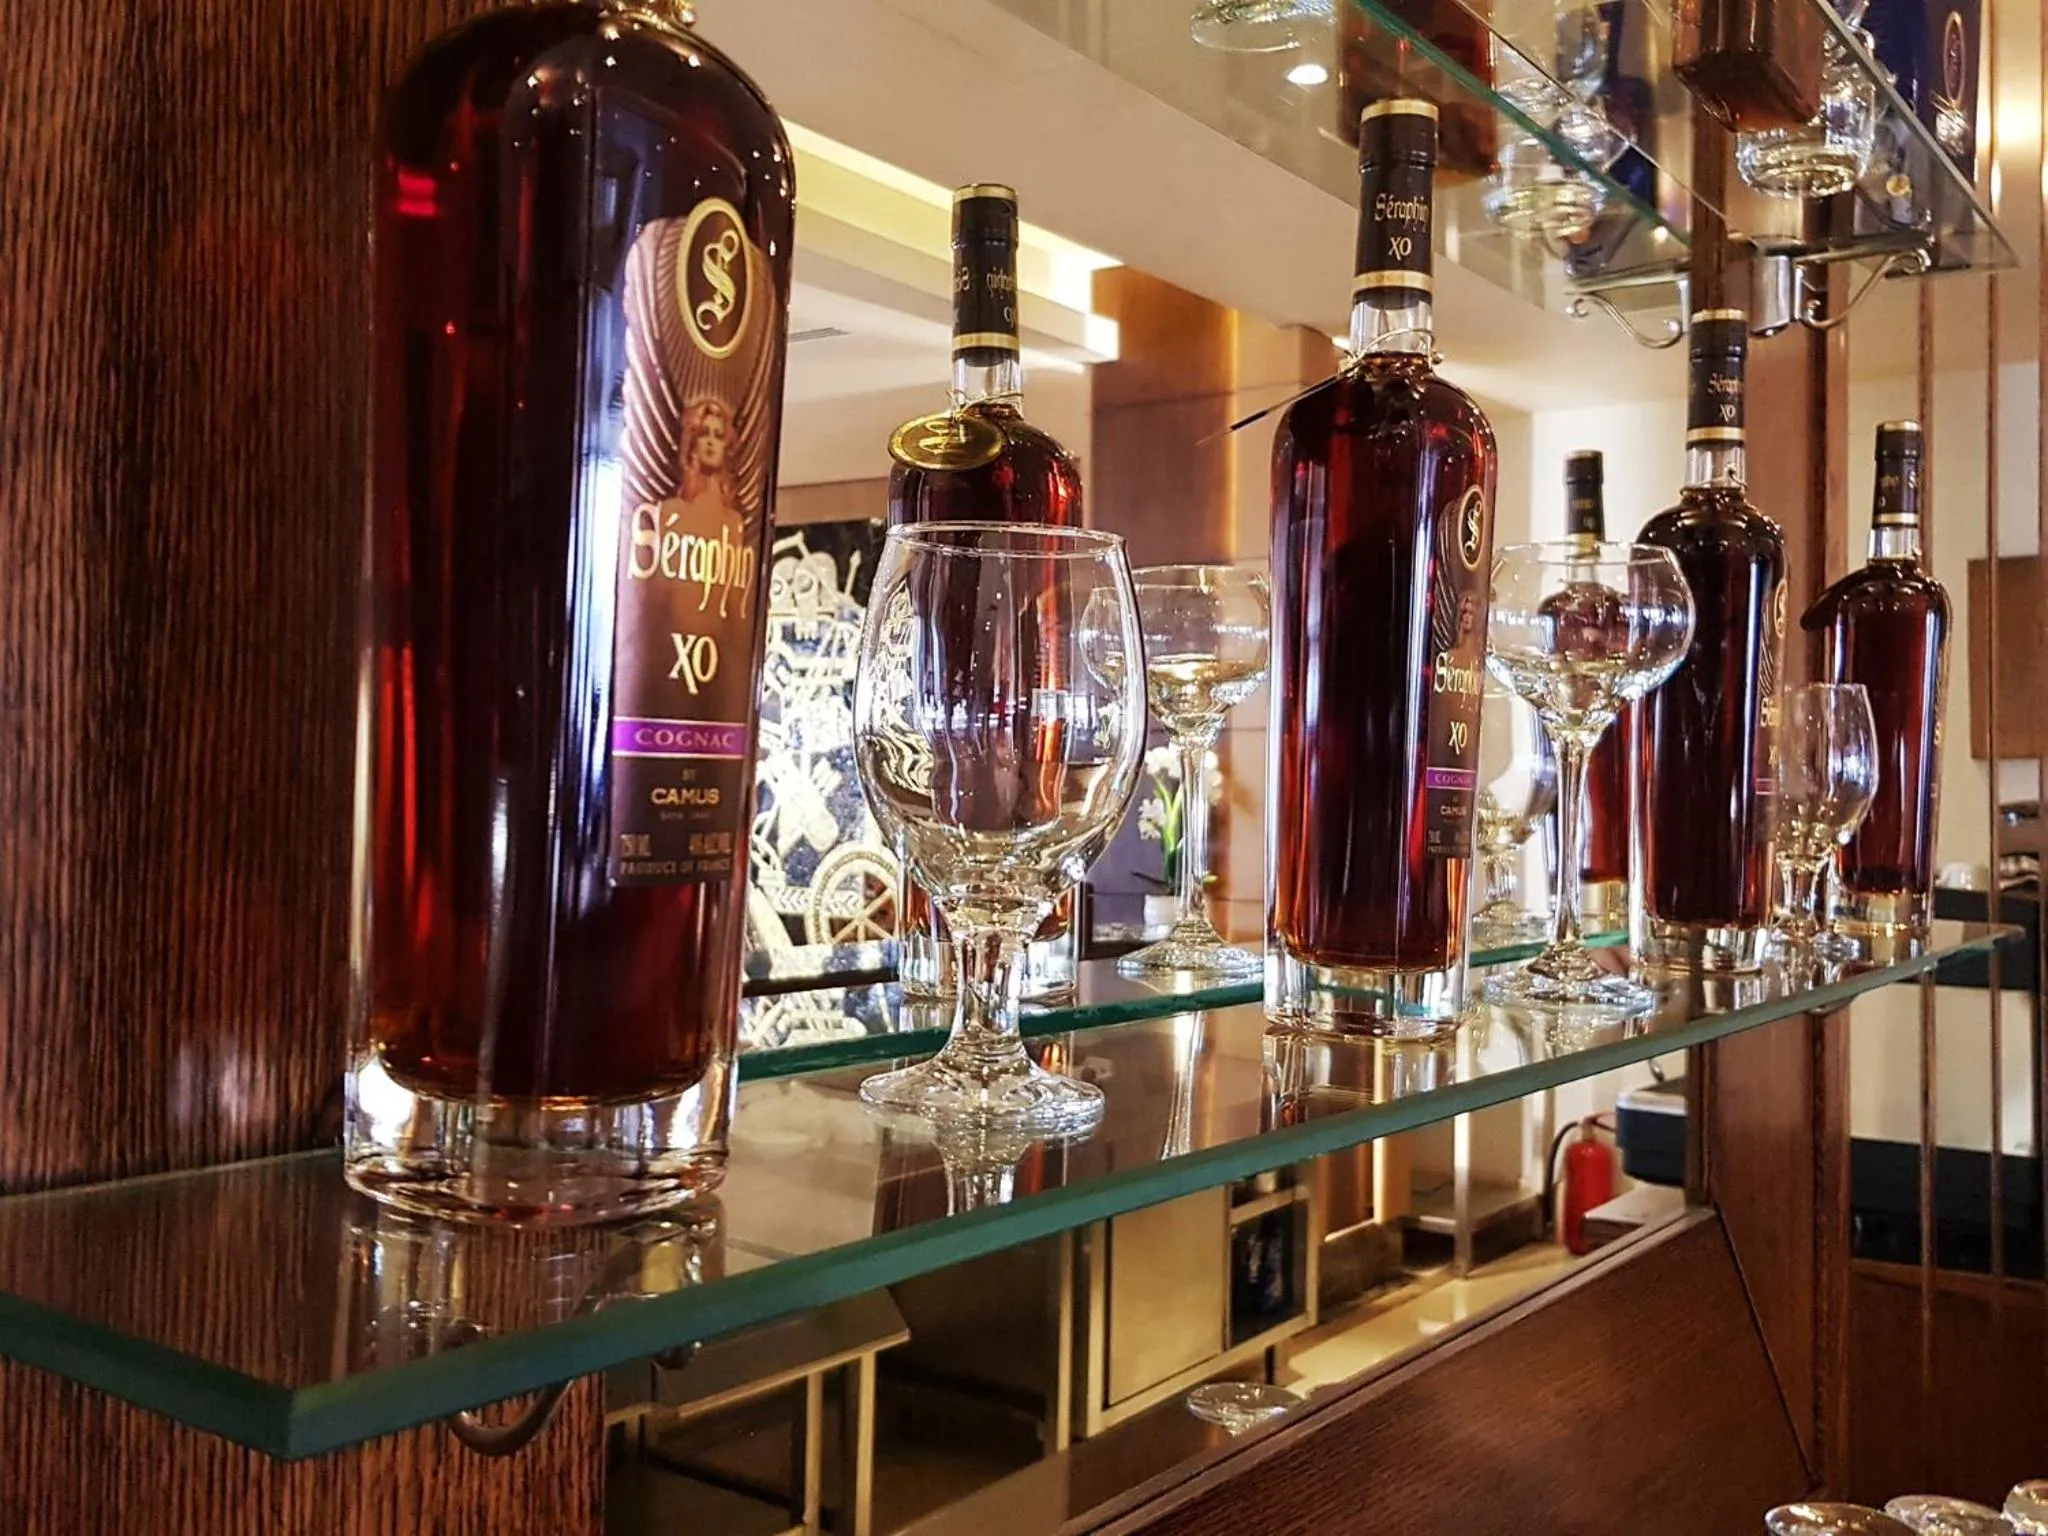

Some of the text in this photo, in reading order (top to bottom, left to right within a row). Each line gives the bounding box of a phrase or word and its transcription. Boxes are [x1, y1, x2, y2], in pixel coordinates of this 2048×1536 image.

[1374, 192, 1429, 233] Séraphin
[1389, 236, 1412, 261] XO
[626, 501, 755, 620] Séraphin
[668, 632, 718, 695] XO
[635, 728, 737, 749] COGNAC
[1448, 720, 1468, 755] XO
[651, 787, 721, 805] CAMUS
